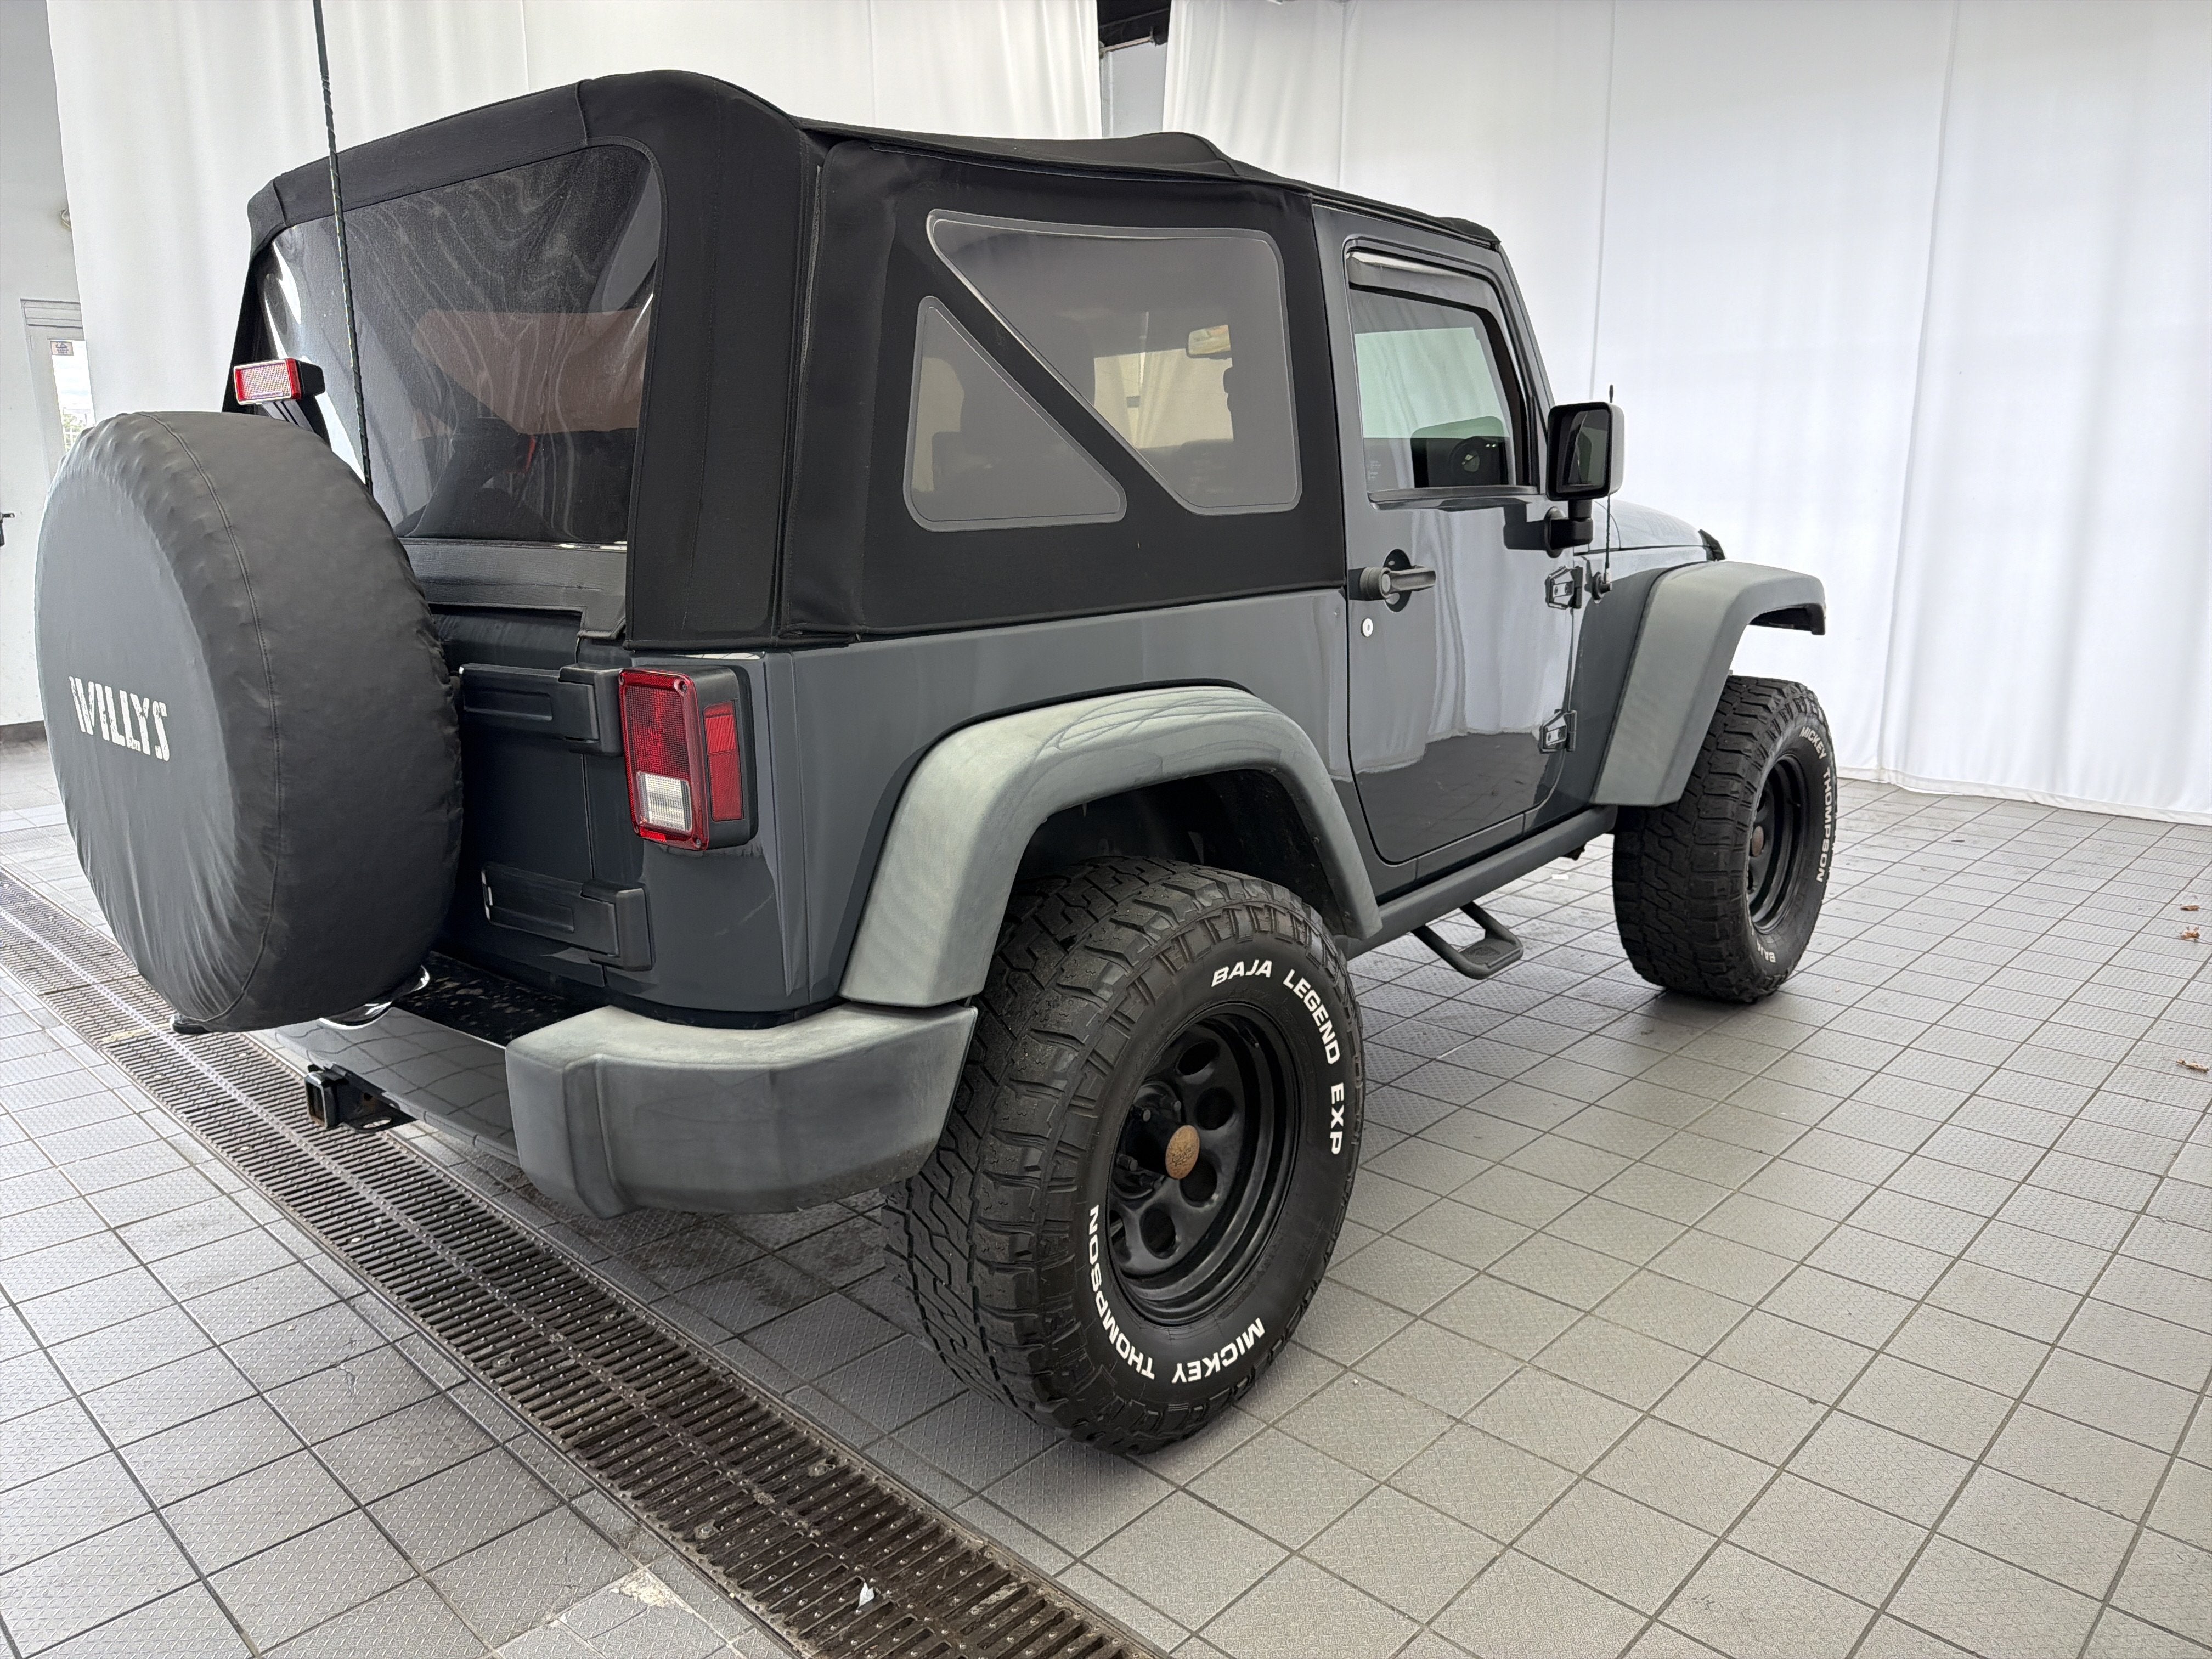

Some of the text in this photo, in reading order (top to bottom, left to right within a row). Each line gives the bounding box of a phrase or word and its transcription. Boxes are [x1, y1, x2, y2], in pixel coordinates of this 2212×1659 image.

[69, 676, 170, 761] WILLYS
[1799, 726, 1832, 882] MICKEY THOMPSON
[1211, 959, 1344, 1154] BAJA LEGEND EXP
[1088, 1204, 1265, 1384] MICKEY THOMPSON
